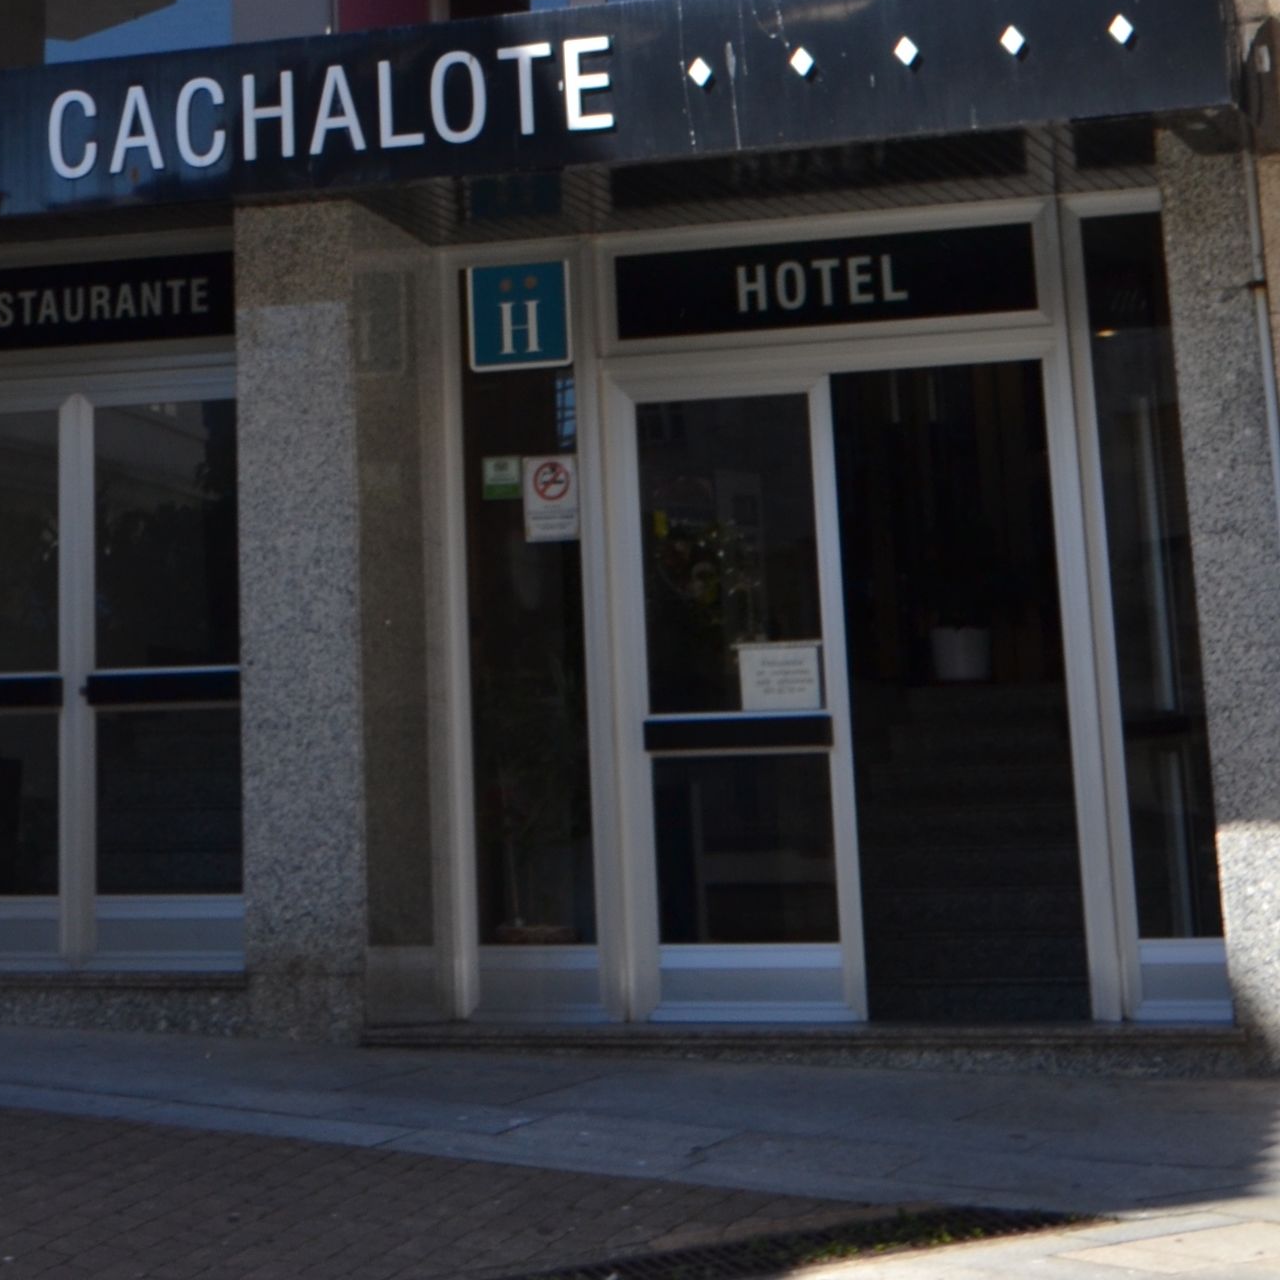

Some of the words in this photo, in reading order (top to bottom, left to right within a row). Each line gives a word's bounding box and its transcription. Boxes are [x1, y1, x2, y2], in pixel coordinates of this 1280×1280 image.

[47, 35, 615, 180] CACHALOTE
[735, 254, 909, 313] HOTEL
[498, 299, 541, 354] H
